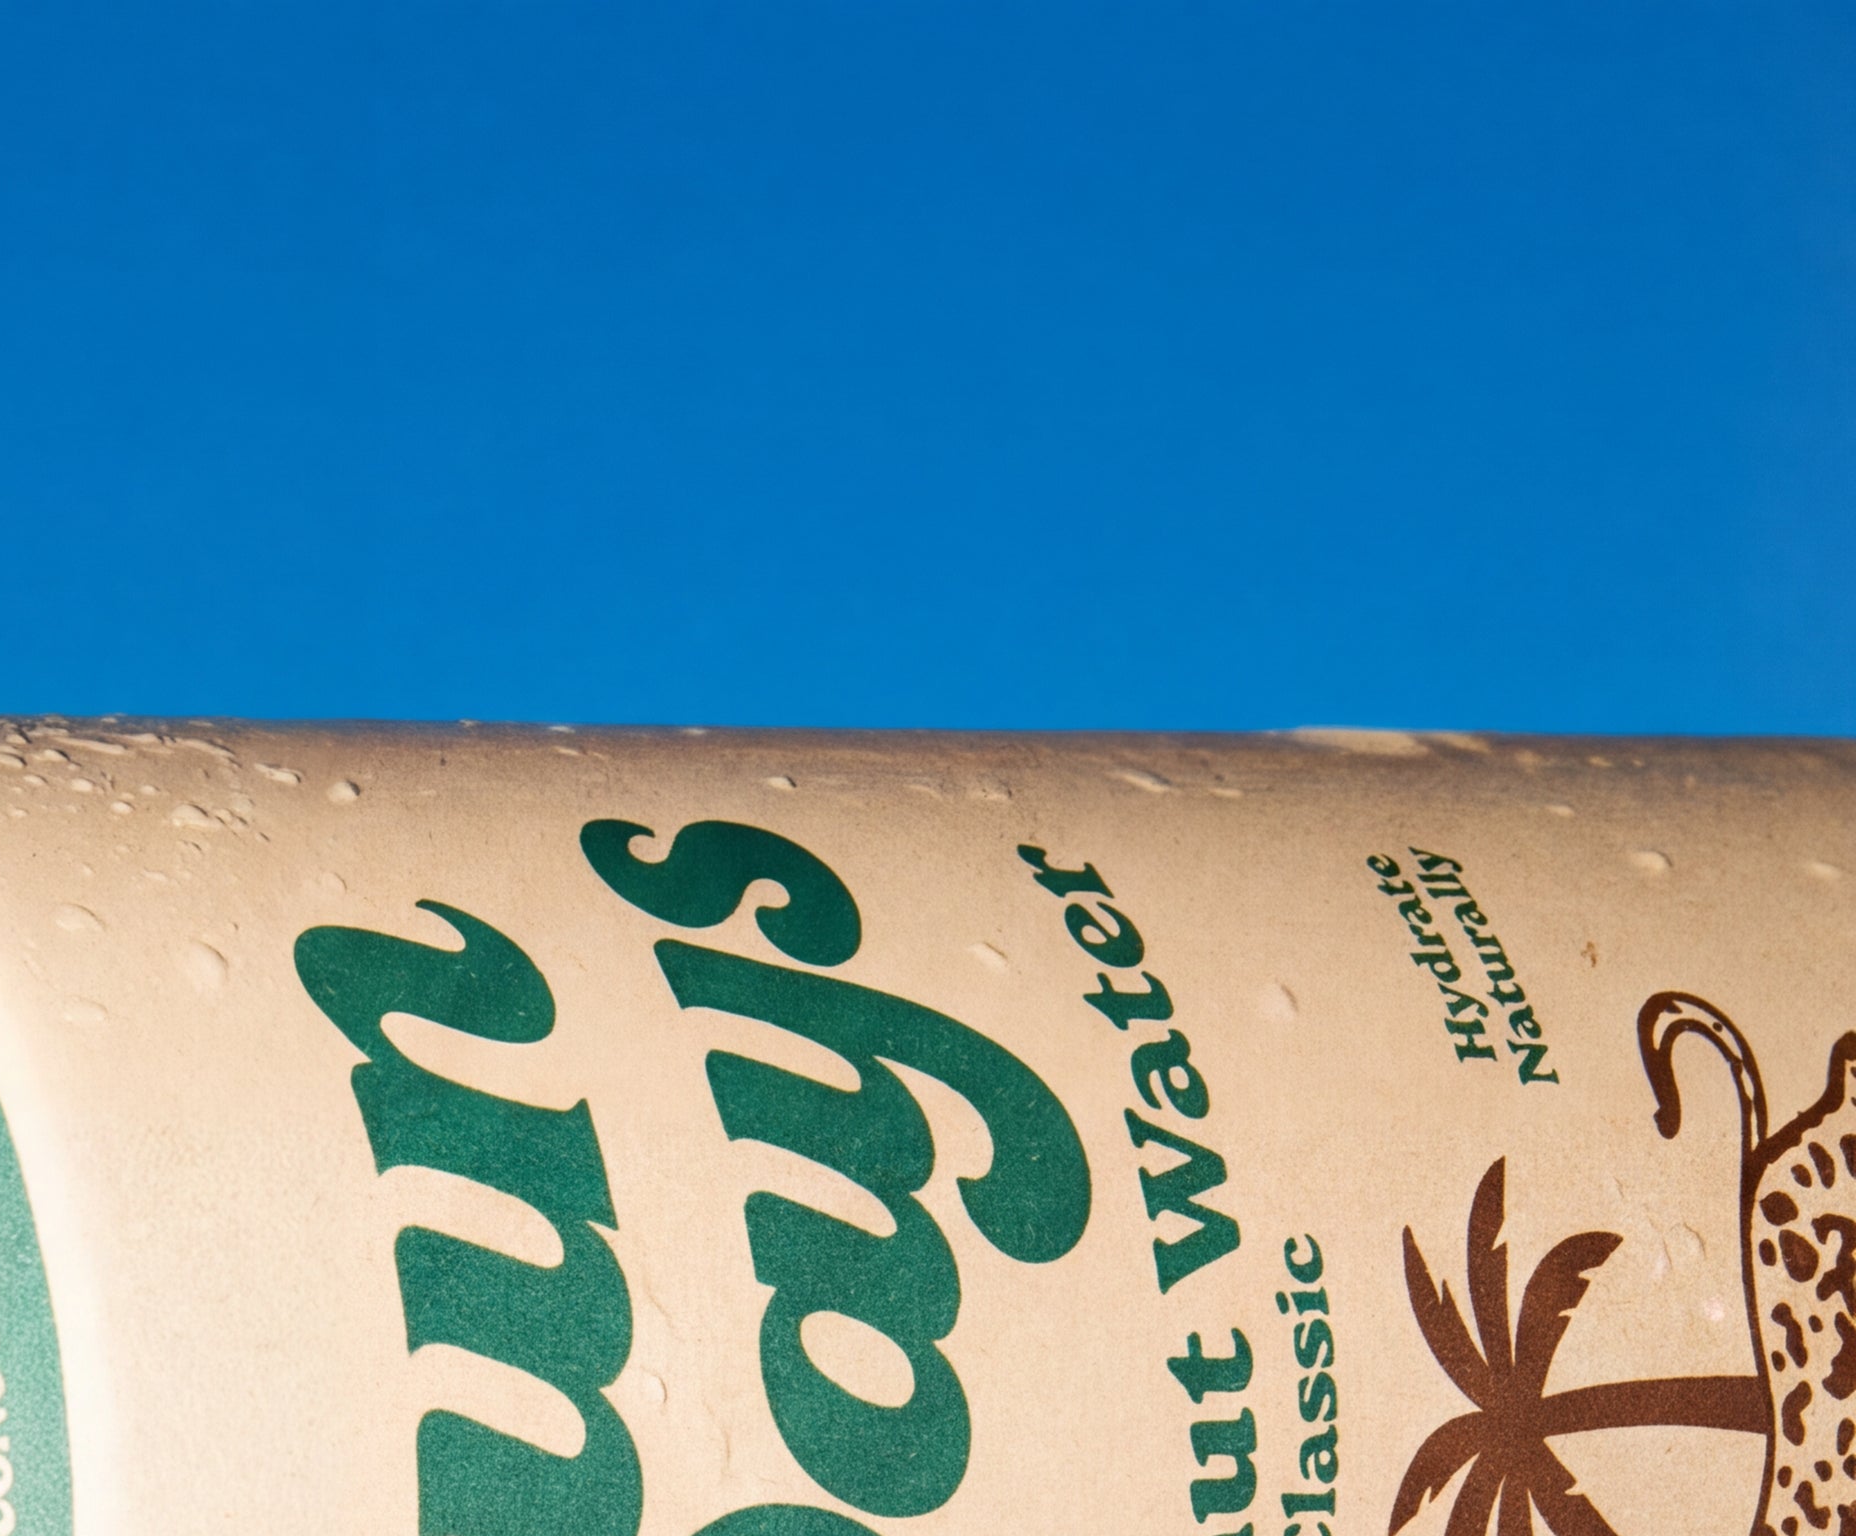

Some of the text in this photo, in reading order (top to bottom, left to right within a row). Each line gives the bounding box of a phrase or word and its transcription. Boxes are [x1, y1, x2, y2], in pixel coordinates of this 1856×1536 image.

[1016, 843, 1241, 1295] Water
[1367, 852, 1497, 1063] Hydrate
[1409, 846, 1559, 1085] Naturally
